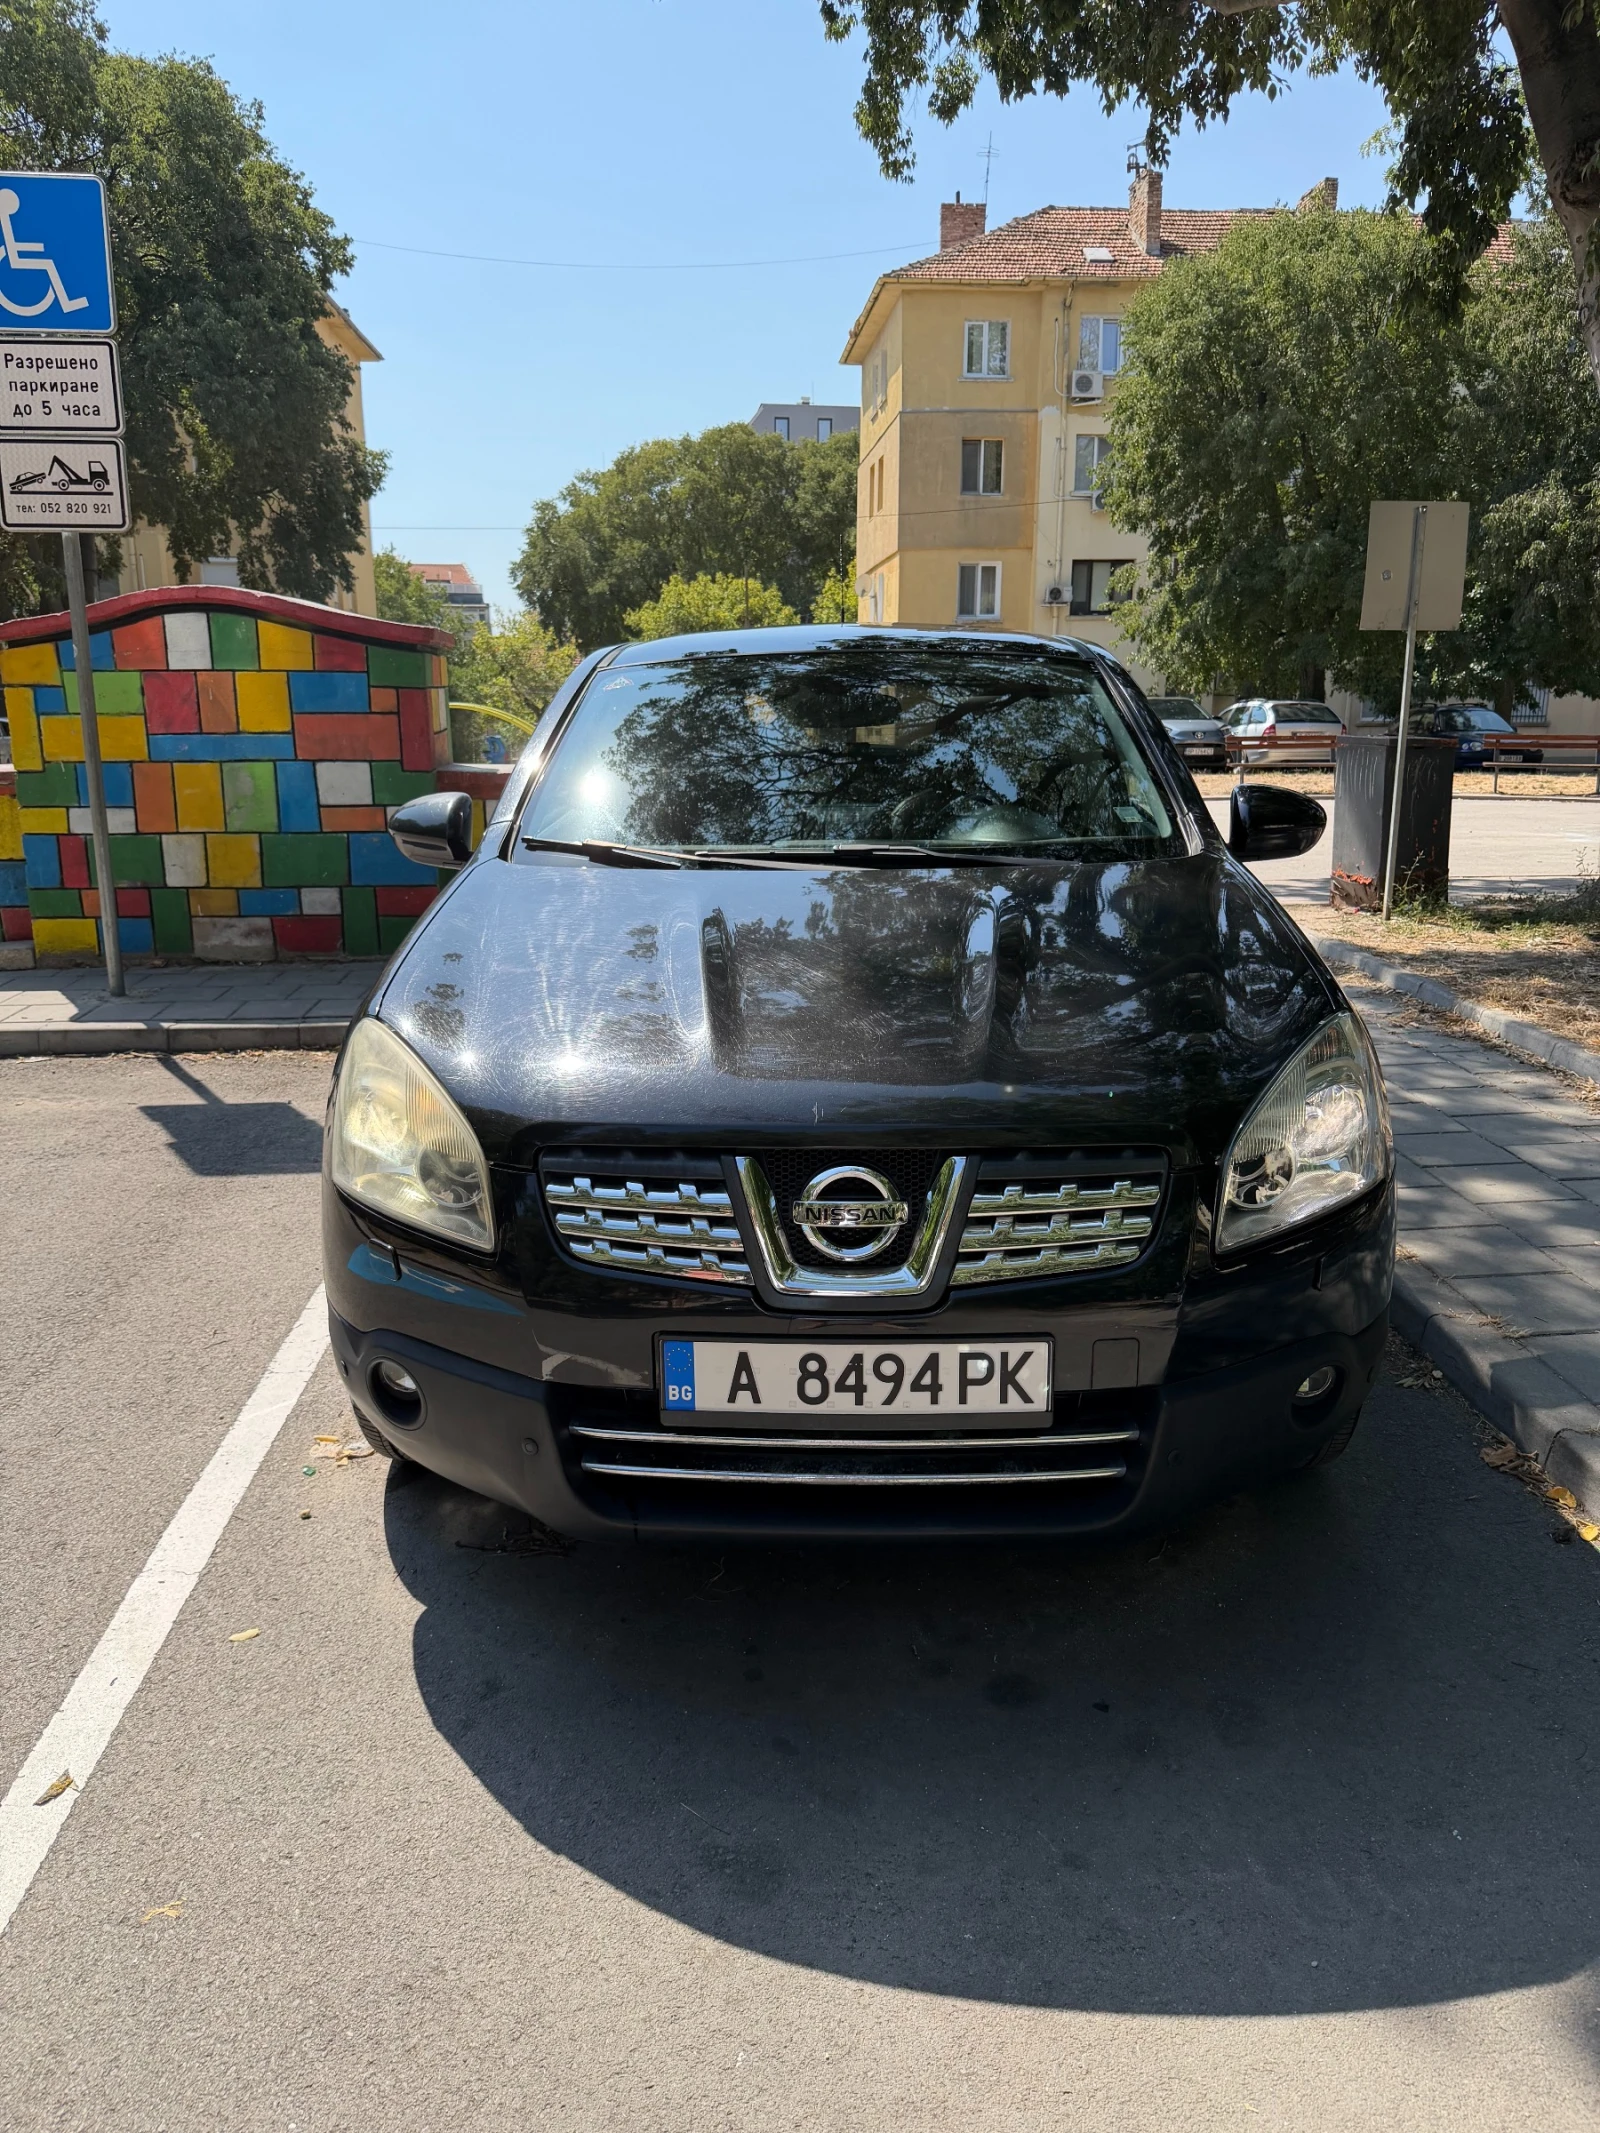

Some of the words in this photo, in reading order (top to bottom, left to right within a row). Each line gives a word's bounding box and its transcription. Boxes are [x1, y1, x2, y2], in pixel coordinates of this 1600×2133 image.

[4, 353, 98, 373] Разрешено
[9, 380, 99, 396] паркиране
[13, 403, 32, 418] до
[42, 400, 52, 416] 5
[62, 403, 101, 416] часа
[16, 504, 36, 513] тел:
[40, 502, 61, 513] 052
[66, 502, 88, 514] 820
[93, 503, 111, 514] 921
[805, 1207, 895, 1222] NISSAN
[727, 1351, 762, 1404] A
[668, 1385, 693, 1401] BG
